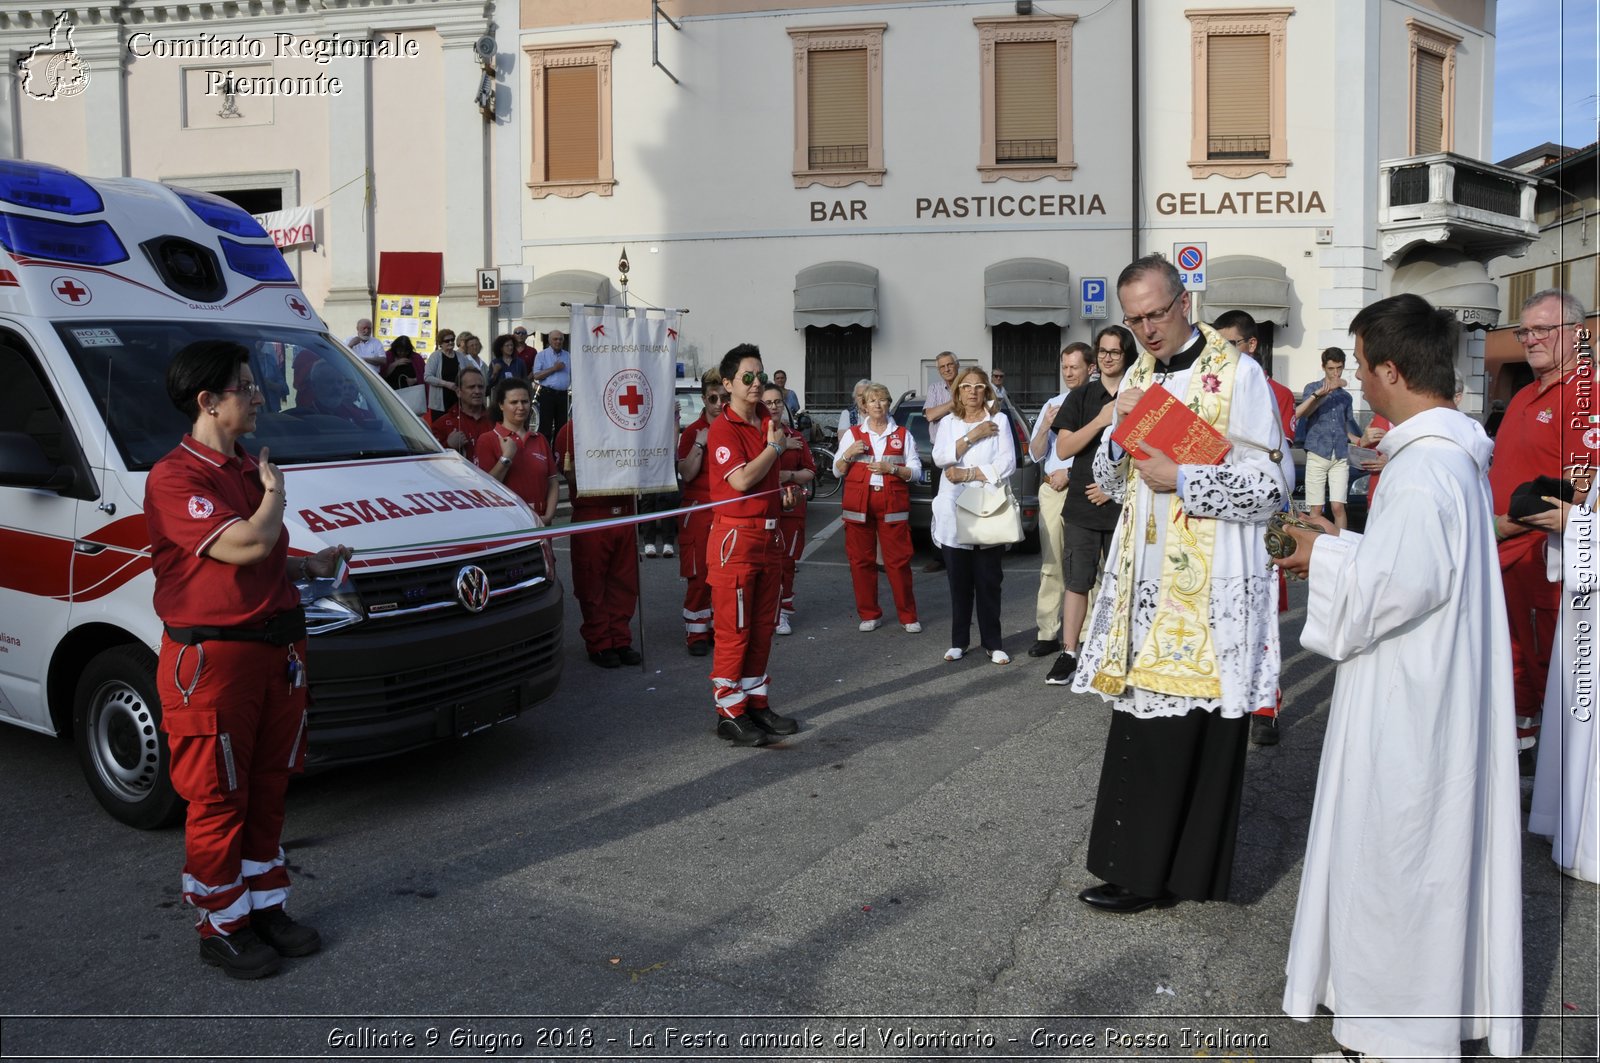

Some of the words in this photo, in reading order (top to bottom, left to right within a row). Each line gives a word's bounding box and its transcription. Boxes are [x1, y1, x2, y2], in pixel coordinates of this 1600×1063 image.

[810, 200, 868, 222] BAR
[915, 194, 1107, 219] PASTICCERIA
[1155, 190, 1327, 215] GELATERIA
[1087, 283, 1101, 299] P
[189, 302, 225, 312] GALLIATE
[84, 338, 97, 346] 12
[581, 344, 609, 354] CROCE
[611, 344, 640, 353] ROSSA
[1135, 407, 1156, 431] DELLA
[585, 448, 636, 459] COMITATO
[0, 632, 21, 647] liana
